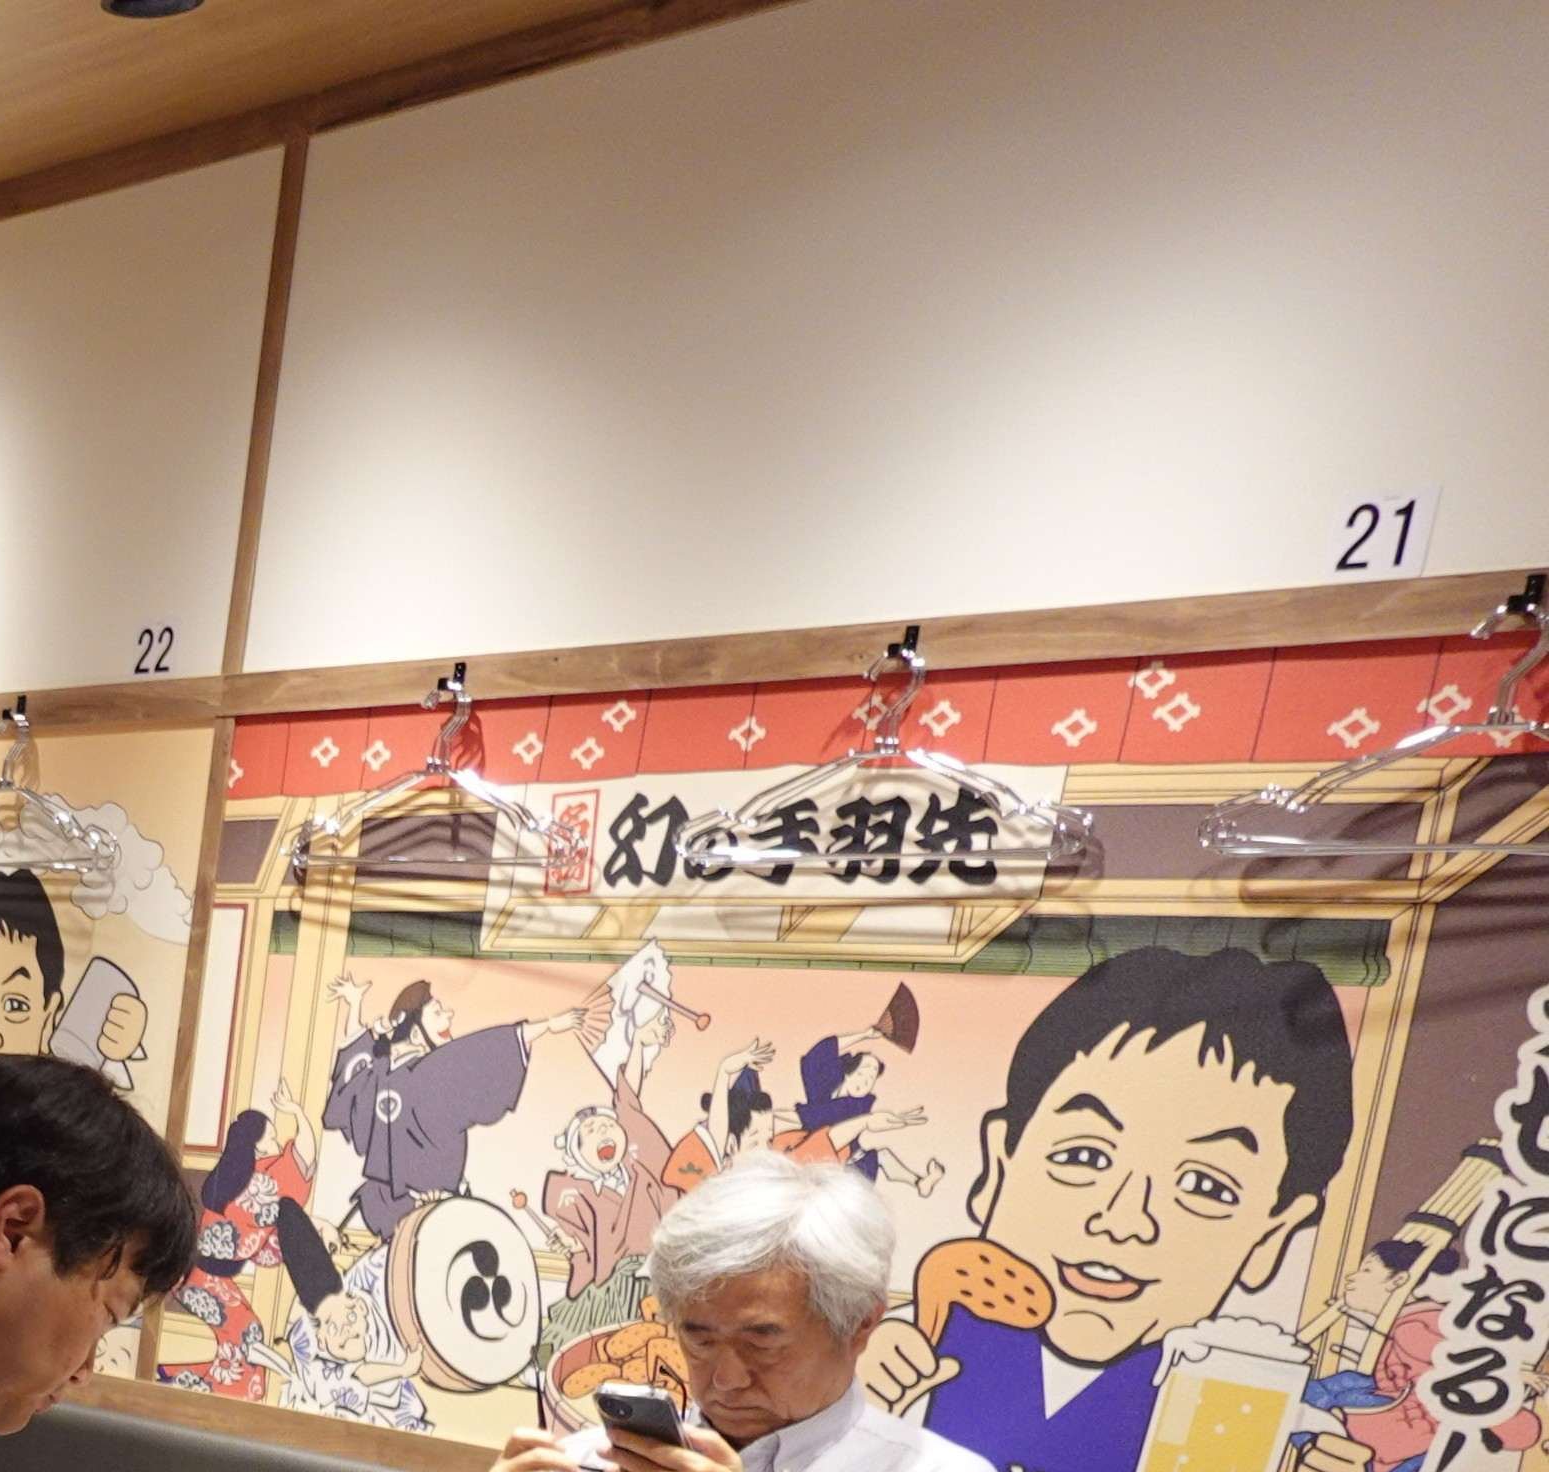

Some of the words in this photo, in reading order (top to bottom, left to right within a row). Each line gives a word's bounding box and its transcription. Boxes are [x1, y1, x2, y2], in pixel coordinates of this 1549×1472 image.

[1336, 500, 1418, 572] 21
[134, 625, 176, 674] 22
[603, 788, 999, 887] 幻の手羽先
